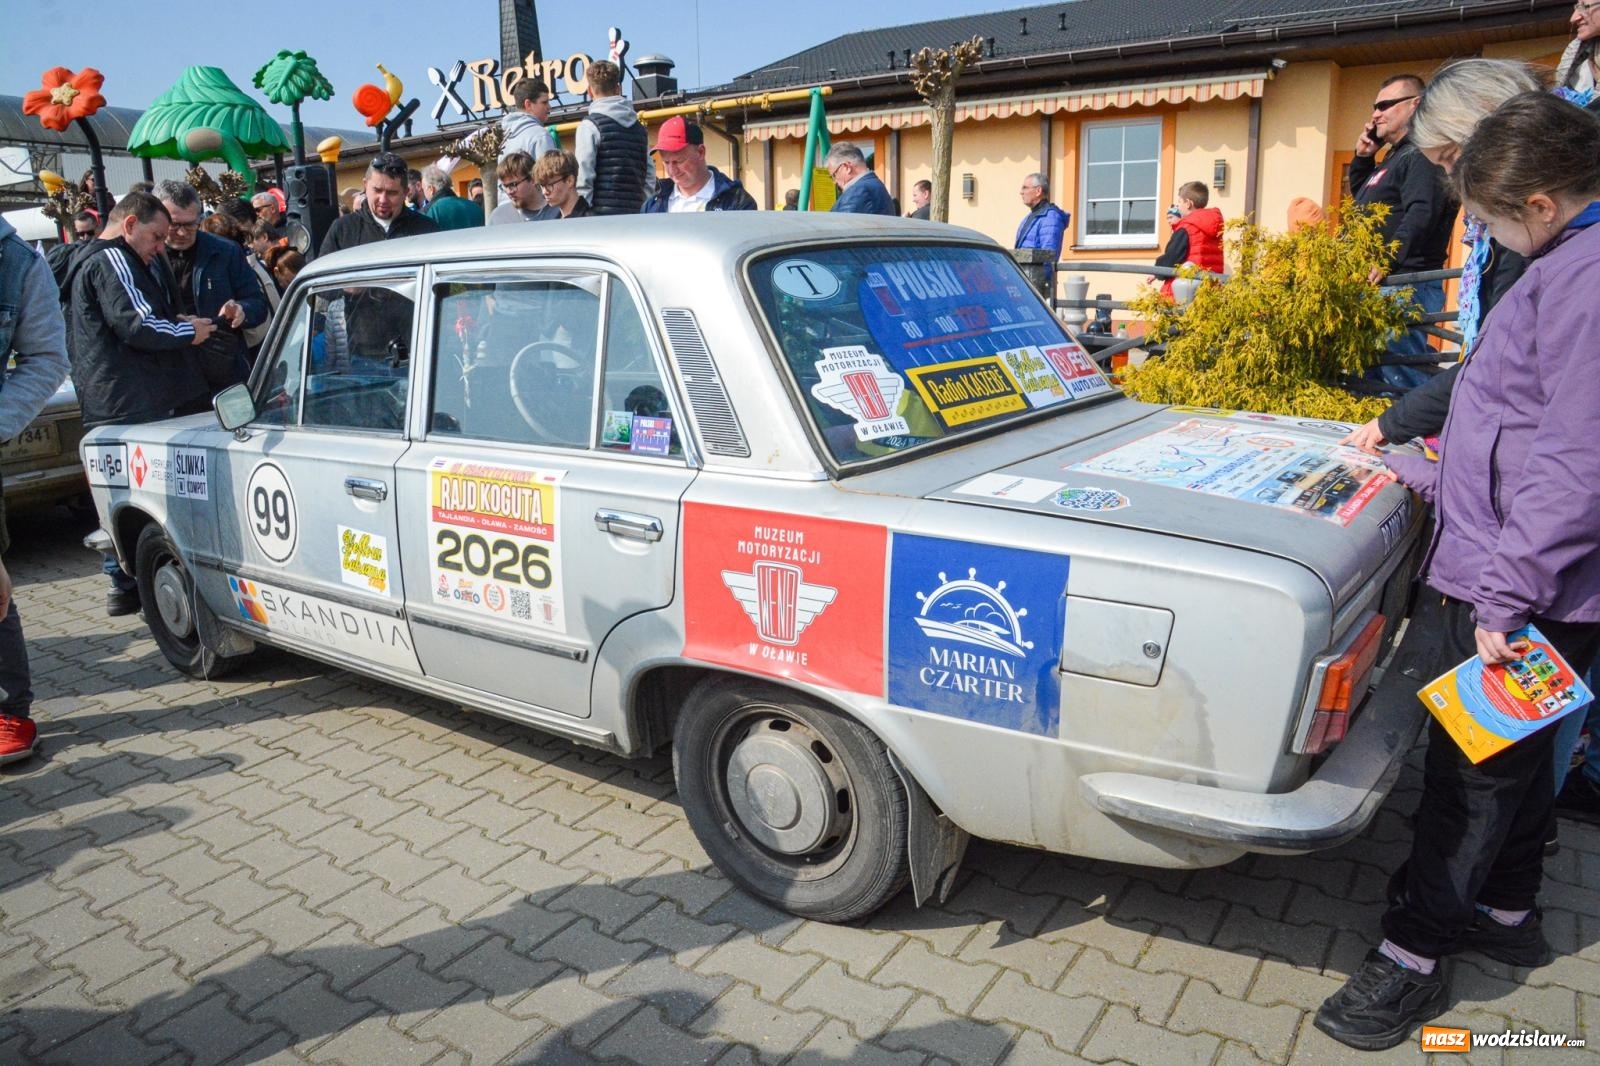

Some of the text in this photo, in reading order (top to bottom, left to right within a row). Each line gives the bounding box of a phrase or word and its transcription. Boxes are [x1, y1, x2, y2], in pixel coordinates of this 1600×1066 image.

[787, 264, 820, 295] T
[882, 260, 965, 300] POLSKI
[901, 320, 923, 339] 80
[935, 315, 959, 334] 100
[821, 359, 881, 373] MOTORYZACJI
[829, 350, 865, 361] MUZEUM
[927, 377, 969, 405] Radio
[1071, 380, 1089, 393] AUTO
[861, 421, 905, 436] W OŁAWIE
[89, 454, 122, 479] FILIPPO
[176, 449, 206, 477] ŚLIWKA
[187, 480, 206, 495] KOMPOT
[440, 476, 544, 525] RAJD KOGUTA
[253, 486, 291, 541] 99
[438, 511, 475, 524] TAJLANDIA
[754, 525, 804, 545] MUZEUM
[436, 529, 552, 590] 2026
[737, 540, 821, 565] MOTORYZACJI
[748, 642, 808, 666] W OŁAWIE
[929, 646, 1015, 680] MARIAN
[919, 666, 1025, 704] CZARTER
